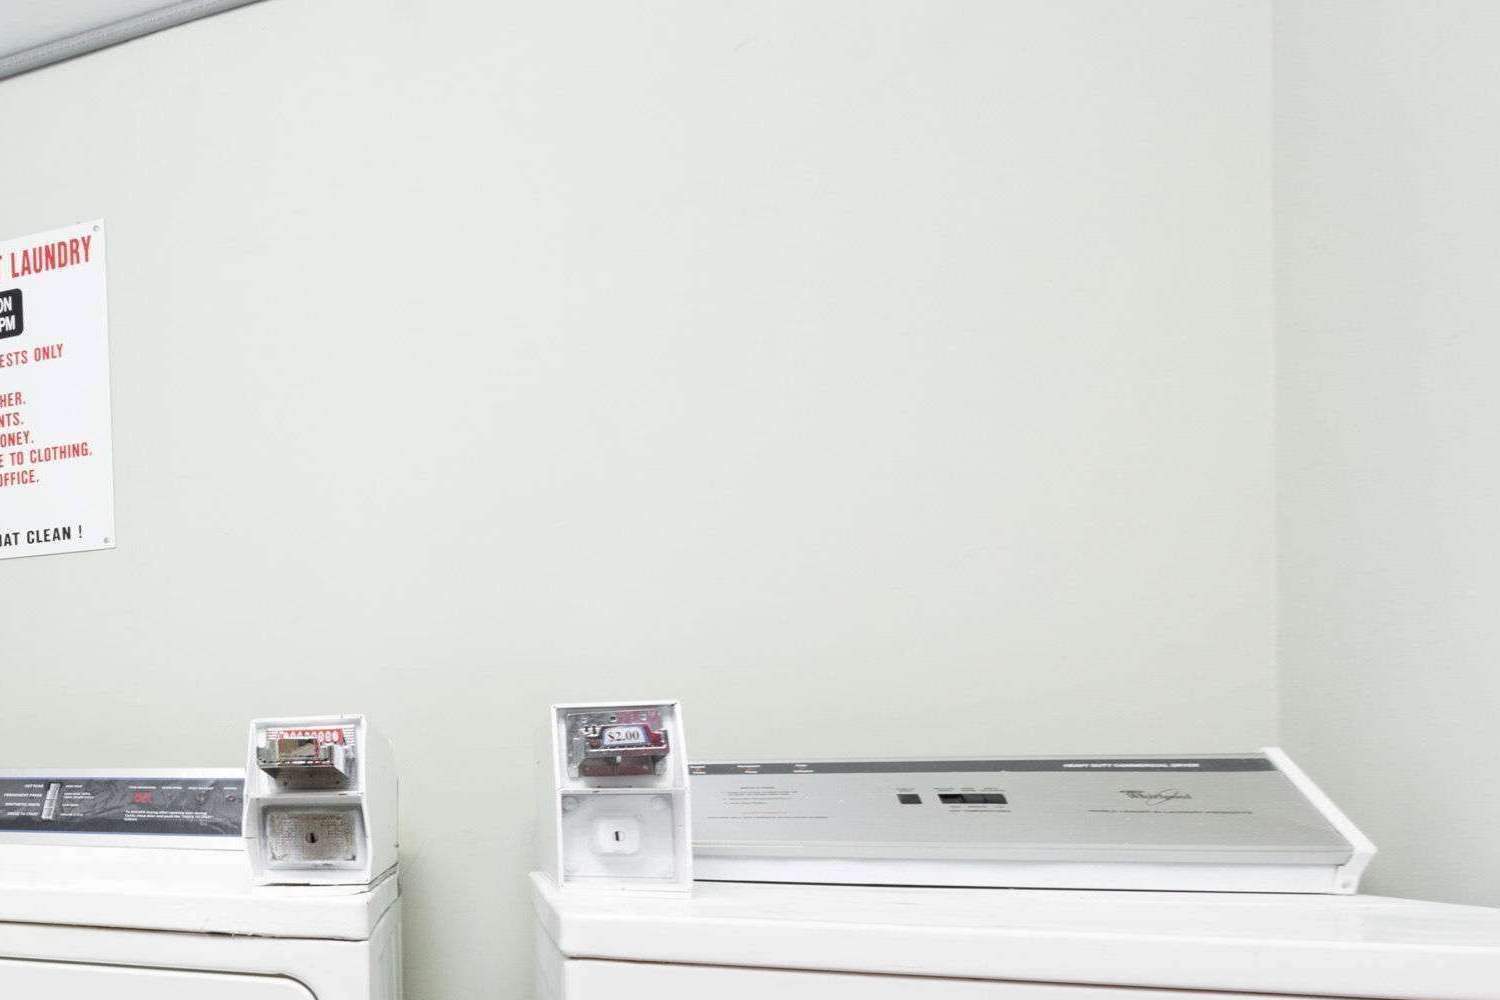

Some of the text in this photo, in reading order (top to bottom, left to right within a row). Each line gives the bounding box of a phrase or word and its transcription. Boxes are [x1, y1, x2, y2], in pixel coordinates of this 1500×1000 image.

[11, 235, 92, 278] LAUNDRY
[34, 344, 64, 362] ONLY
[9, 452, 24, 465] TO
[26, 526, 72, 544] CLEAN
[78, 525, 83, 538] !
[607, 730, 640, 742] $2.00
